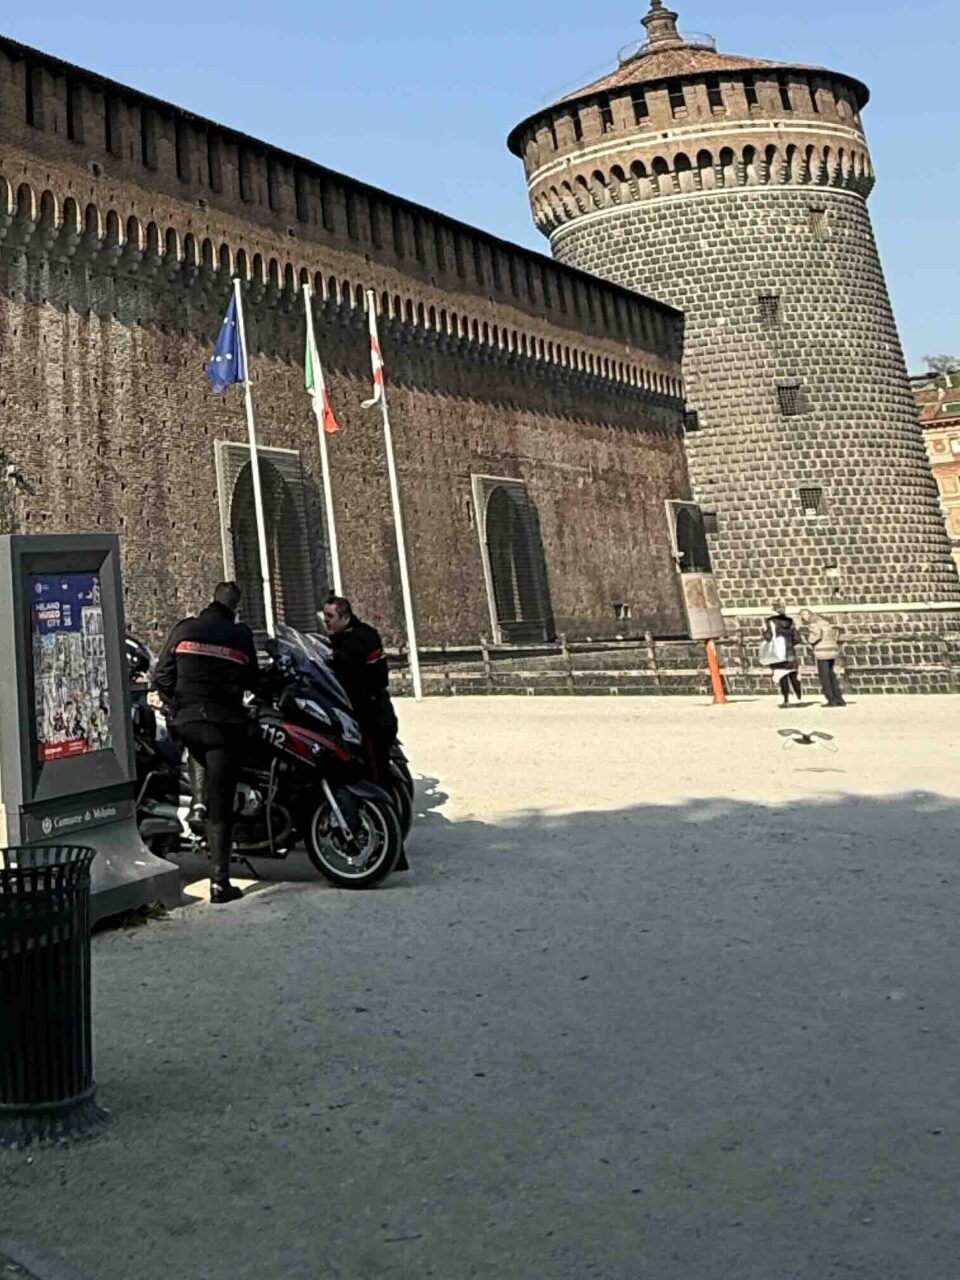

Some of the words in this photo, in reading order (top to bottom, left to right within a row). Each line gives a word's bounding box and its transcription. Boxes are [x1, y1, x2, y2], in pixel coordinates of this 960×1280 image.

[36, 602, 60, 611] MILANO
[38, 610, 60, 619] MUSEO
[260, 724, 286, 750] 112
[54, 815, 83, 828] Comune
[84, 809, 92, 821] di
[93, 807, 117, 819] Milano
